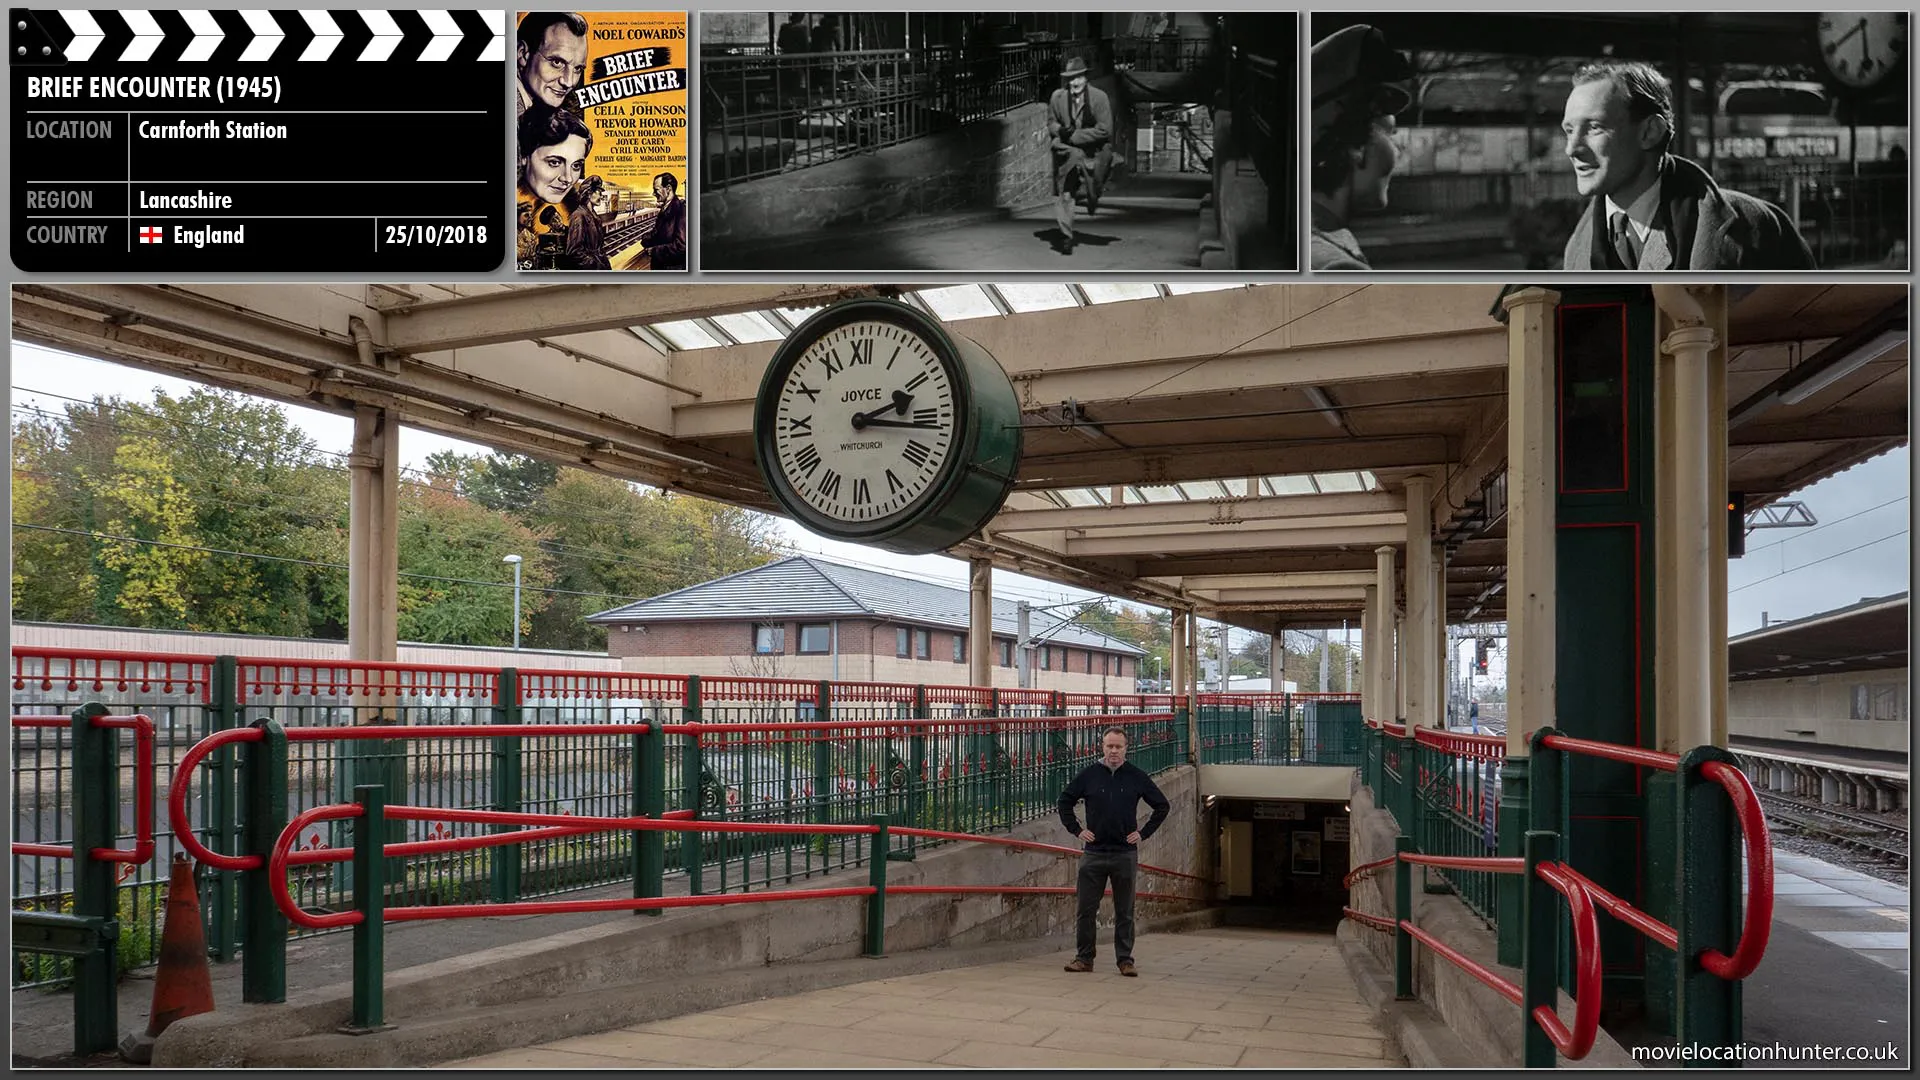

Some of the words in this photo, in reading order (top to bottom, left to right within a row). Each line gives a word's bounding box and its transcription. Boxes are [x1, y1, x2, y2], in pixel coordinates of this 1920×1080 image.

[593, 29, 624, 40] NOEL
[627, 26, 685, 40] COWARD'S
[603, 49, 654, 76] BRIEF
[575, 70, 680, 108] ENCOUNTER
[594, 106, 625, 115] CELIA
[630, 105, 686, 116] JOHNSON
[594, 118, 636, 128] TREVOR
[640, 118, 686, 128] HOWARD
[634, 146, 671, 154] RAYMOND
[850, 339, 874, 367] XII
[819, 348, 844, 380] XI
[796, 381, 821, 403] X
[841, 388, 882, 403] JOYCE
[840, 441, 883, 451] WHITCHURCH
